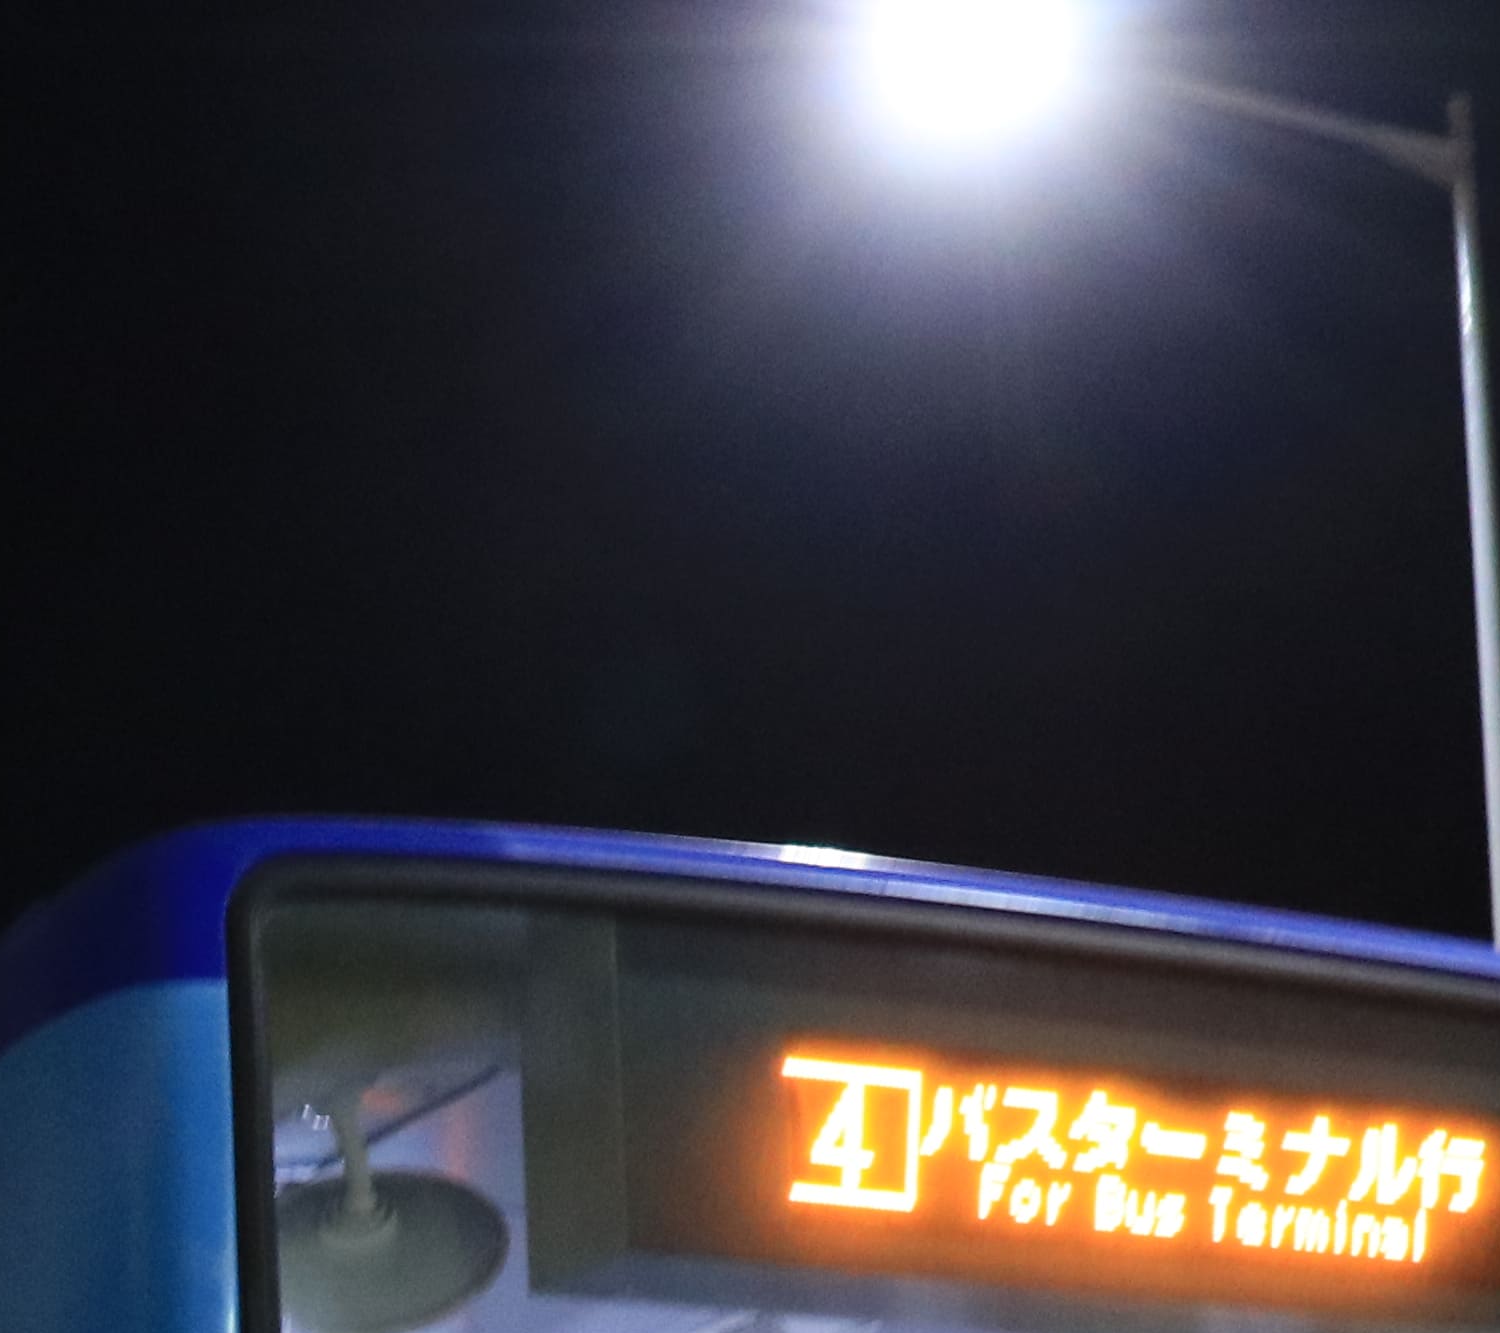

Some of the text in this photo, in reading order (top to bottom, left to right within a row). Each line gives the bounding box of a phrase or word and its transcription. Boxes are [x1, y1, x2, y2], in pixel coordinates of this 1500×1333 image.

[809, 1081, 874, 1188] 4
[919, 1082, 1486, 1213] バスターミナル行
[976, 1162, 1428, 1263] For Bus Terminal
